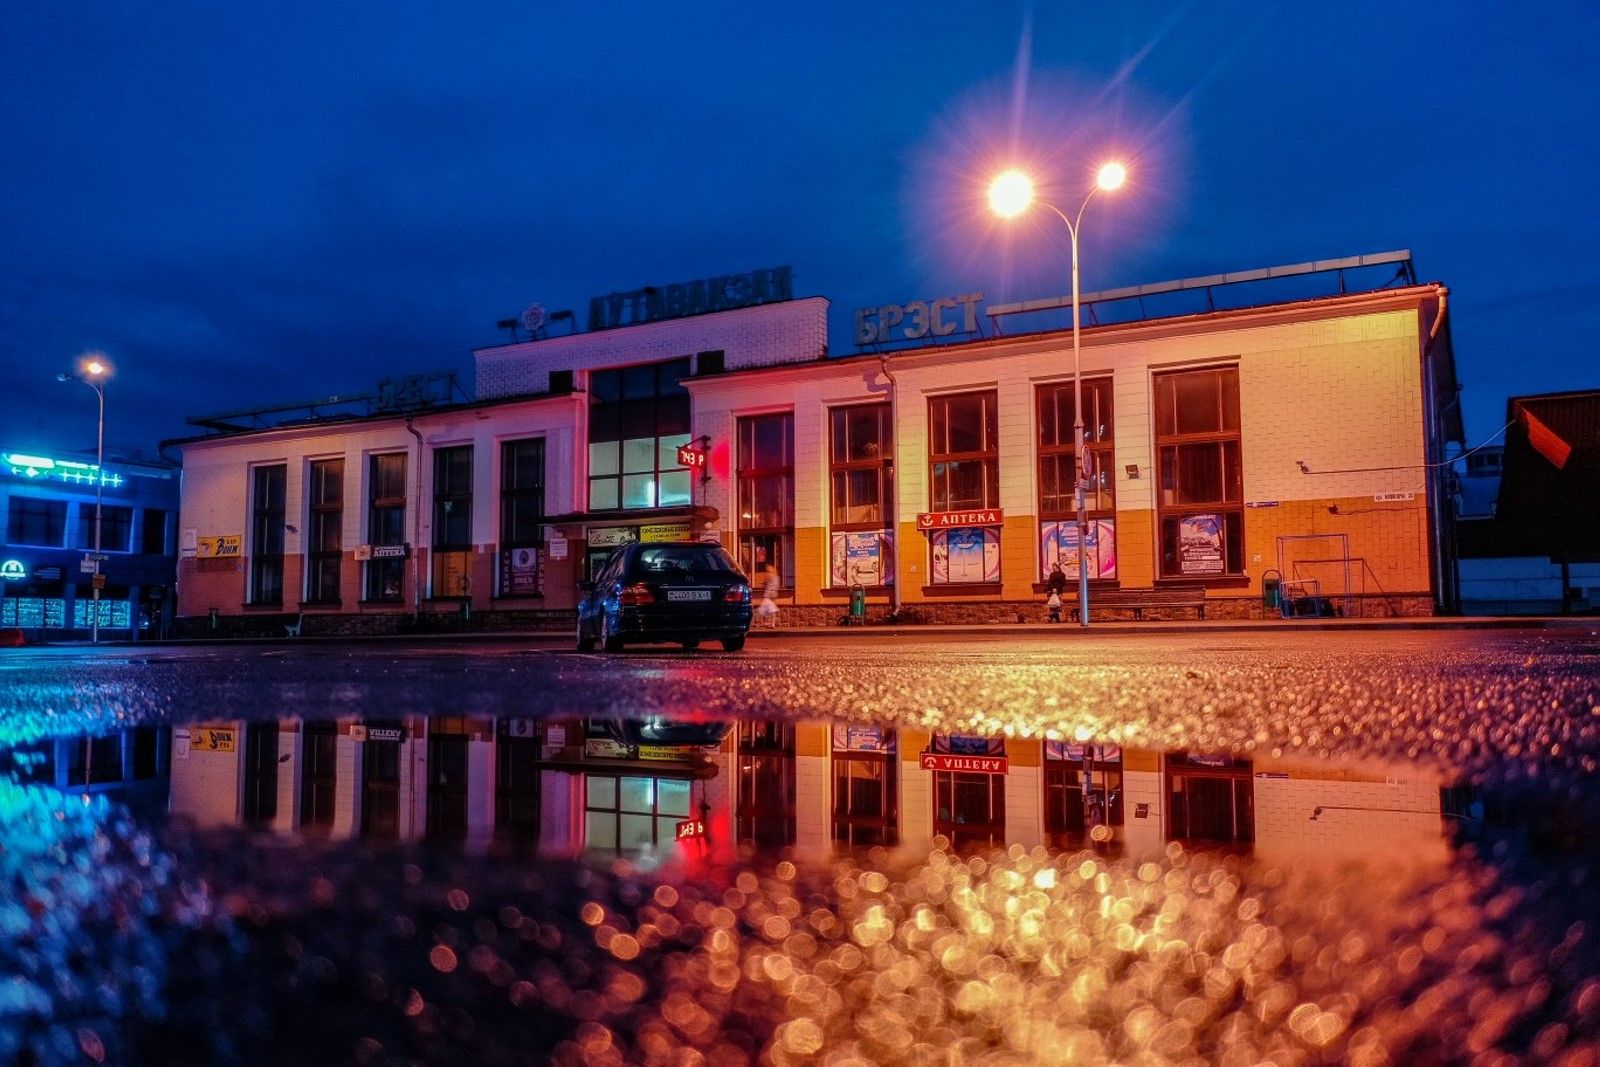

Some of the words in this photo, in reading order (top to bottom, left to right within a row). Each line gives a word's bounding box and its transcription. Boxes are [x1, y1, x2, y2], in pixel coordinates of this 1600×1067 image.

[856, 293, 984, 344] БРЭСТ
[941, 512, 996, 525] АПТЕКА
[374, 549, 406, 557] АПТЕКА
